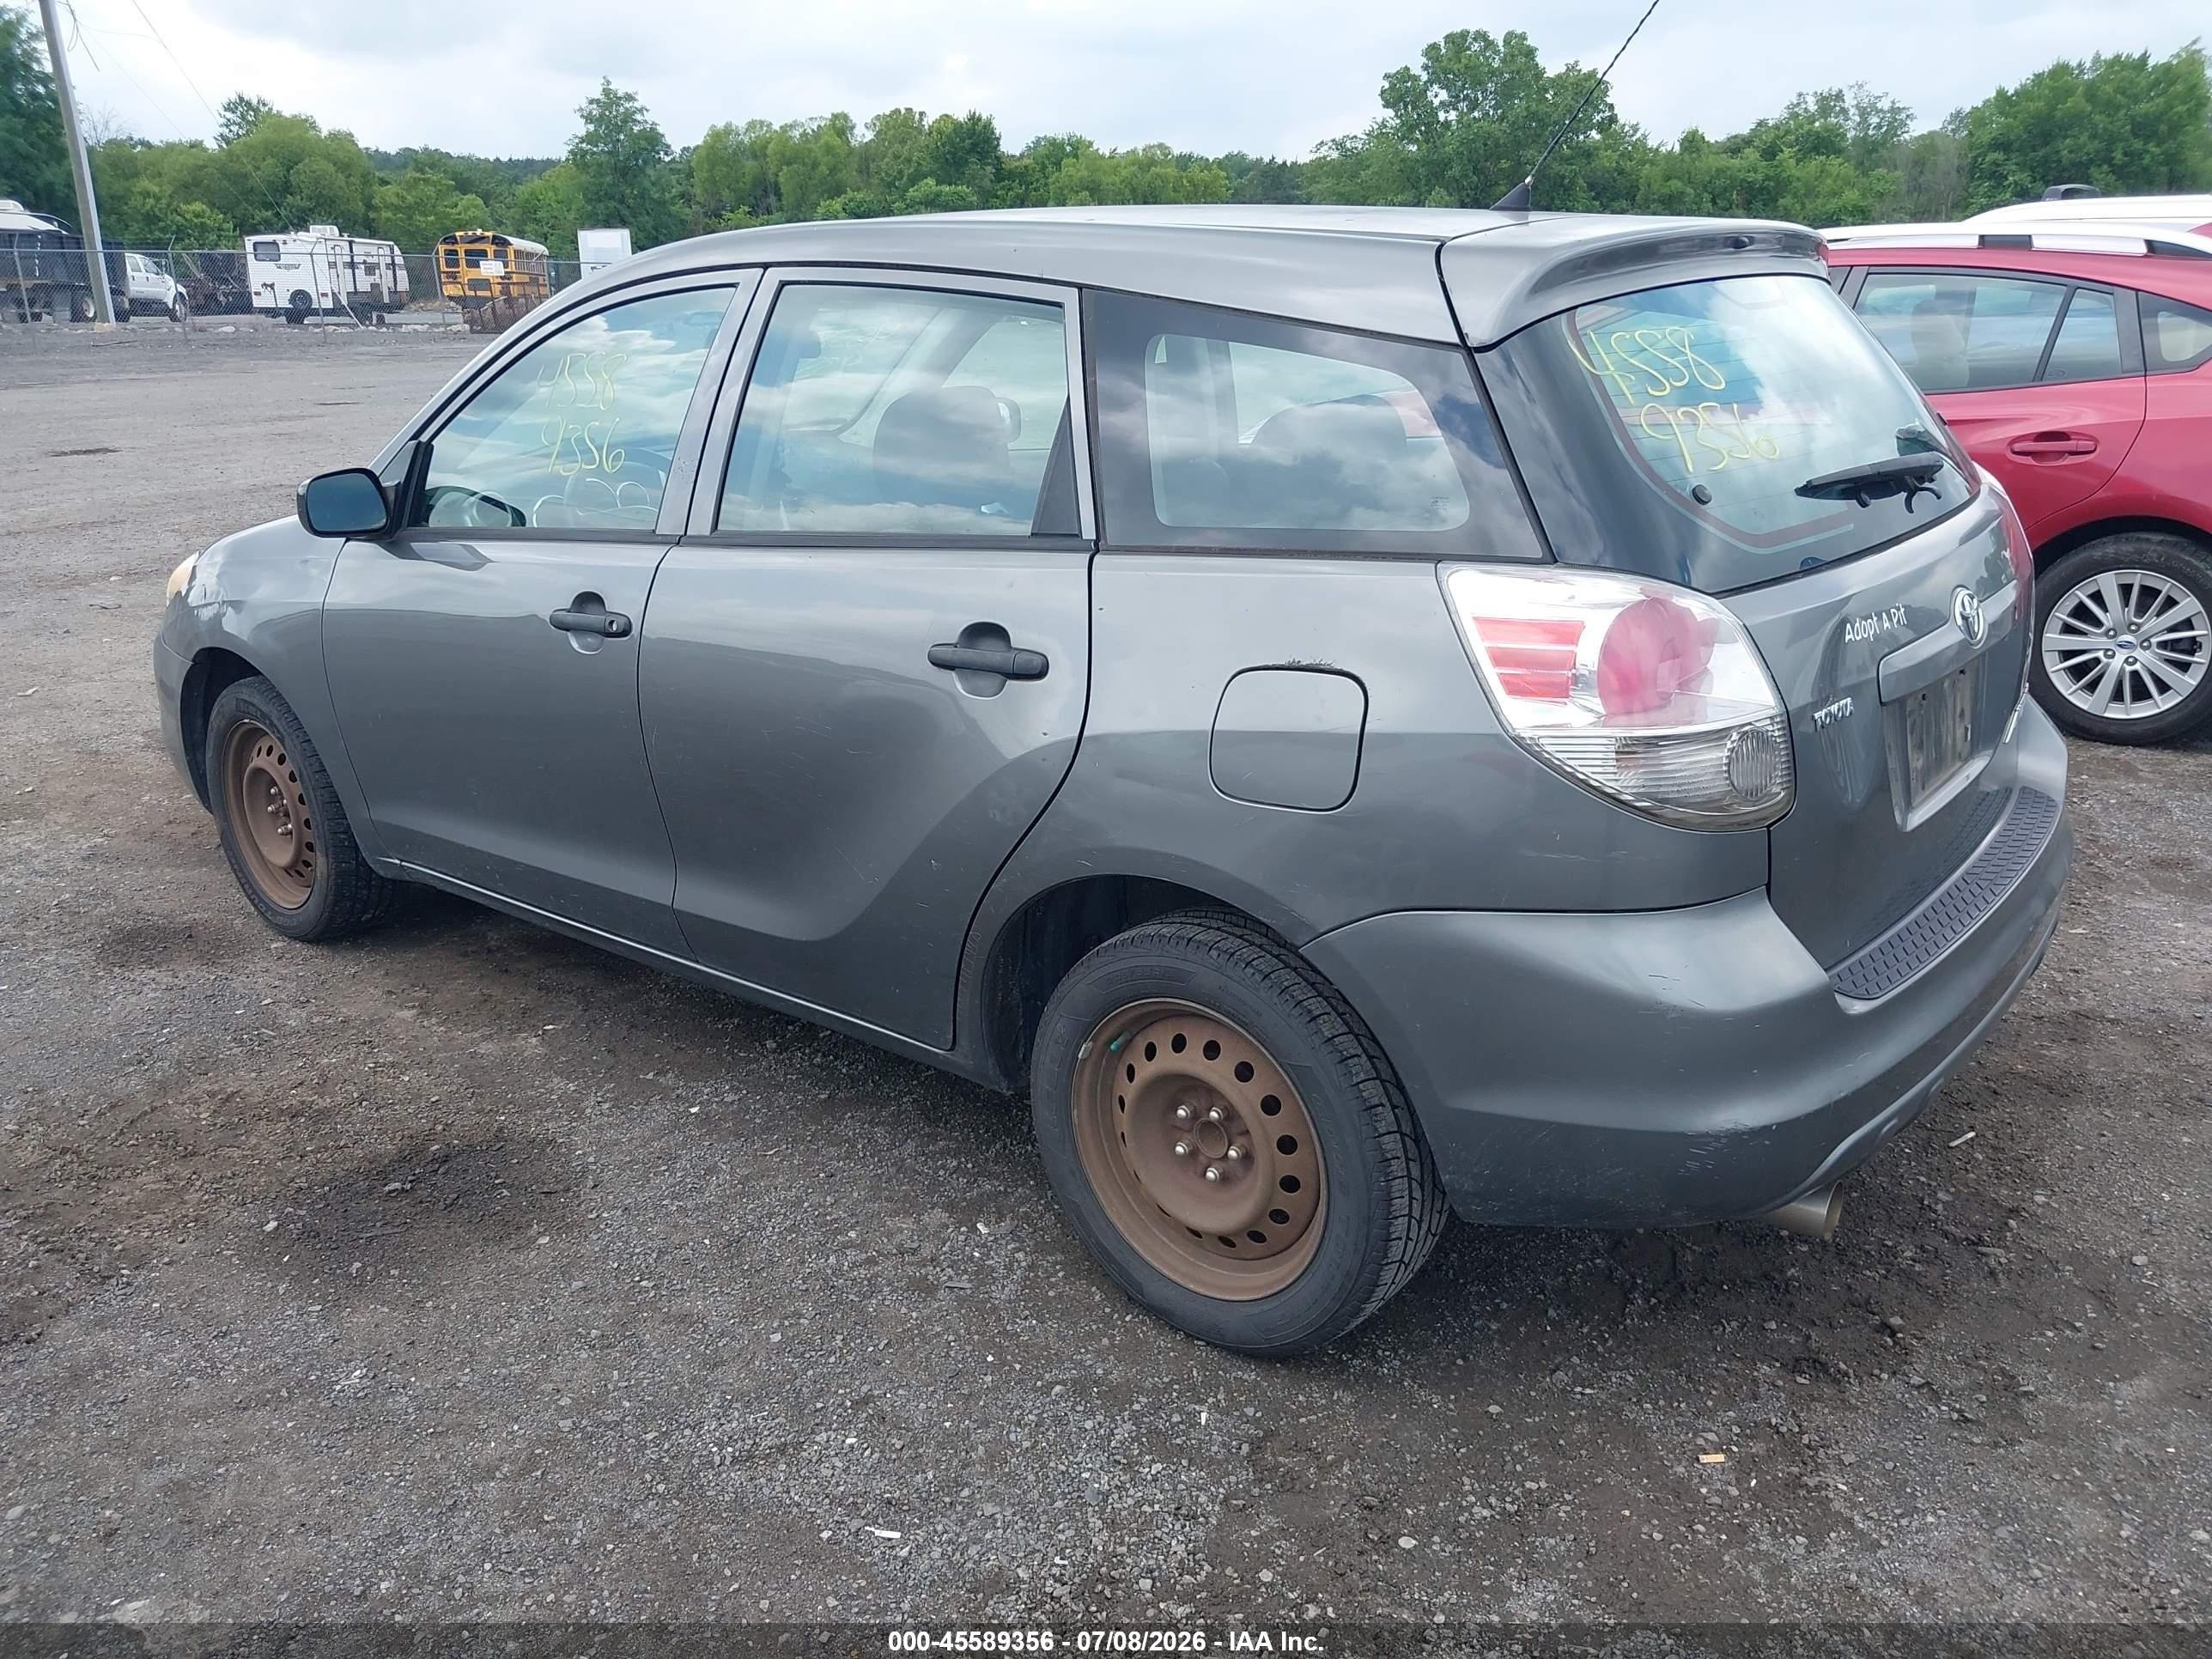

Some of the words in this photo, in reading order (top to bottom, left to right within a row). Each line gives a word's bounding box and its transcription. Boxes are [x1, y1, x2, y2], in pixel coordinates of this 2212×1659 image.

[537, 349, 628, 411] 4558
[1565, 326, 1727, 406] 4558
[1639, 401, 1781, 473] 9356
[1844, 611, 1880, 644] Adopt
[1881, 611, 1891, 631] A
[1890, 602, 1908, 629] Pit
